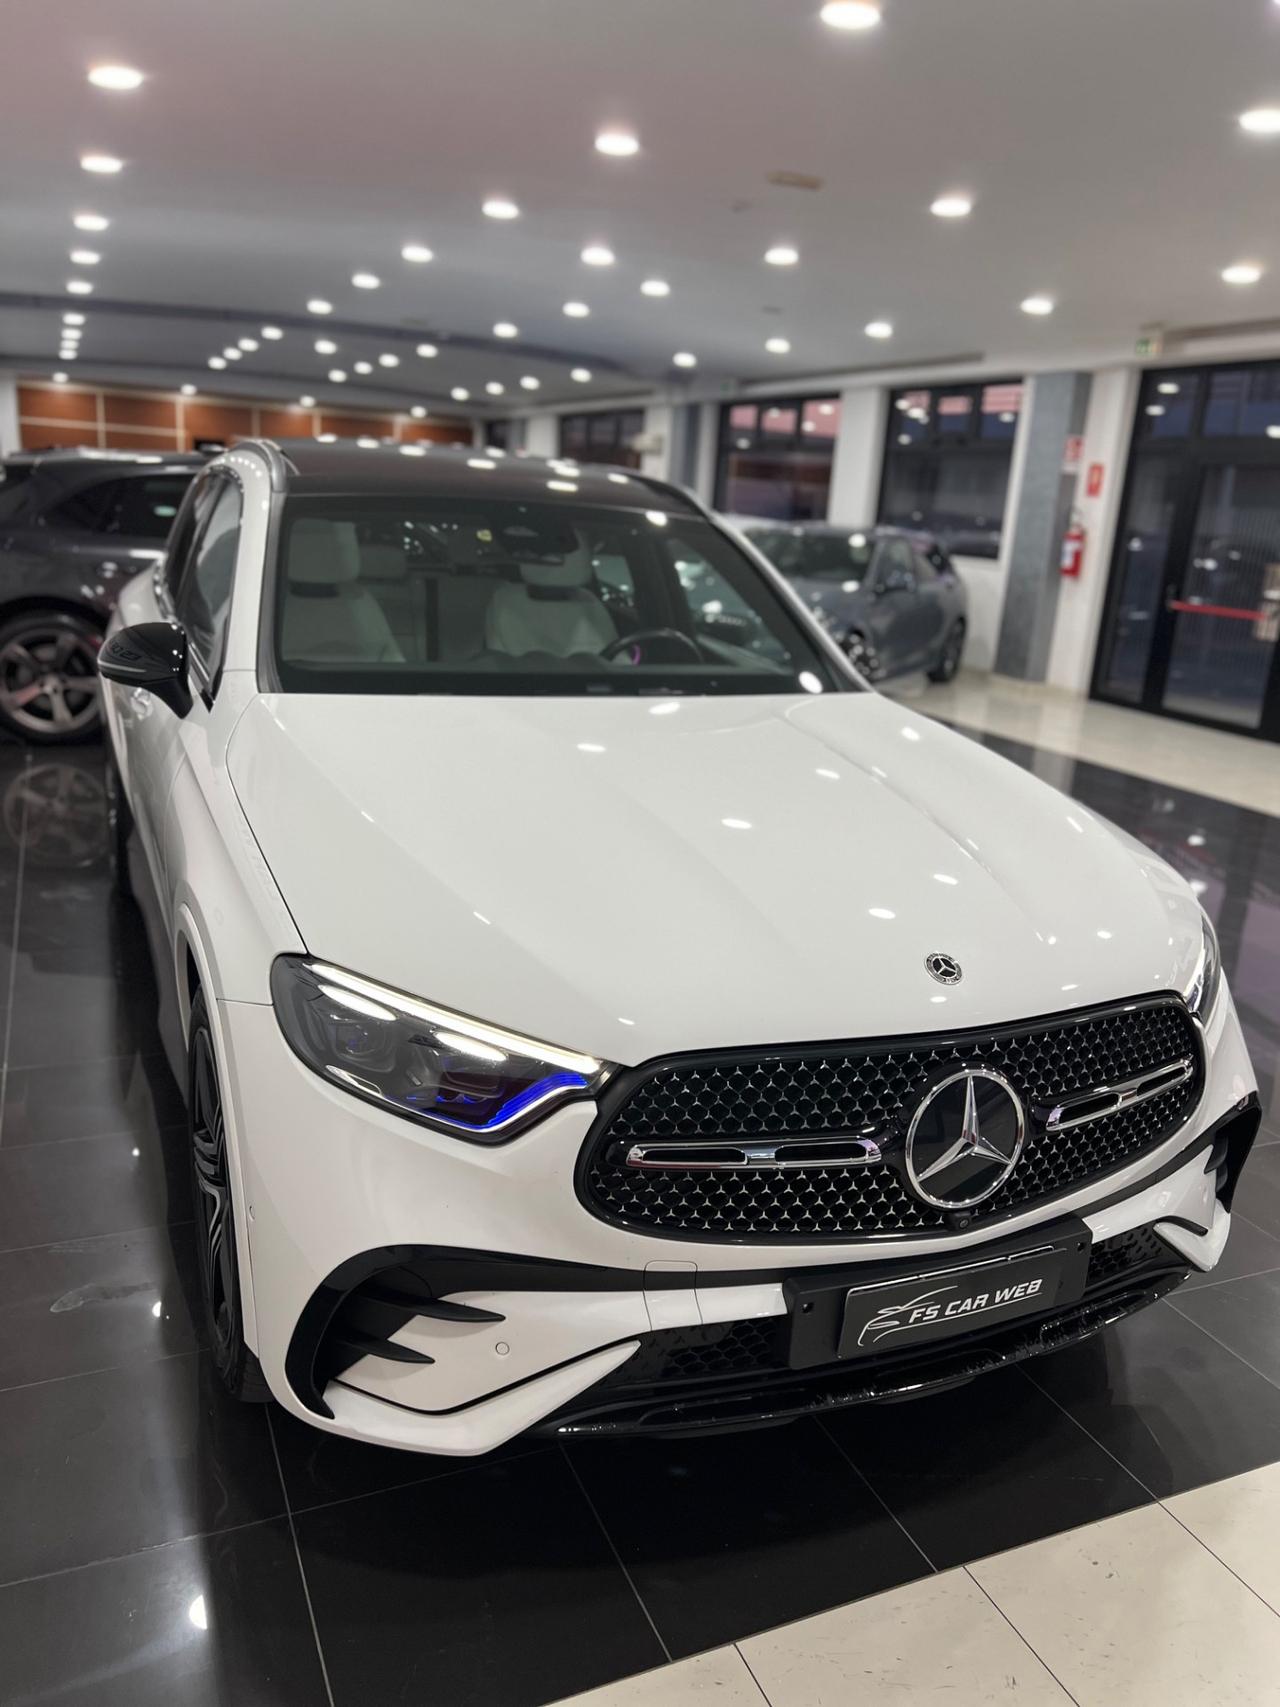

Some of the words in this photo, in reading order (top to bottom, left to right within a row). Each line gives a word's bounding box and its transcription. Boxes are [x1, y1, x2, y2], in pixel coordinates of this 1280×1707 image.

[909, 1305, 941, 1323] FS
[944, 1294, 989, 1315] CAR
[995, 1279, 1042, 1303] WEB
